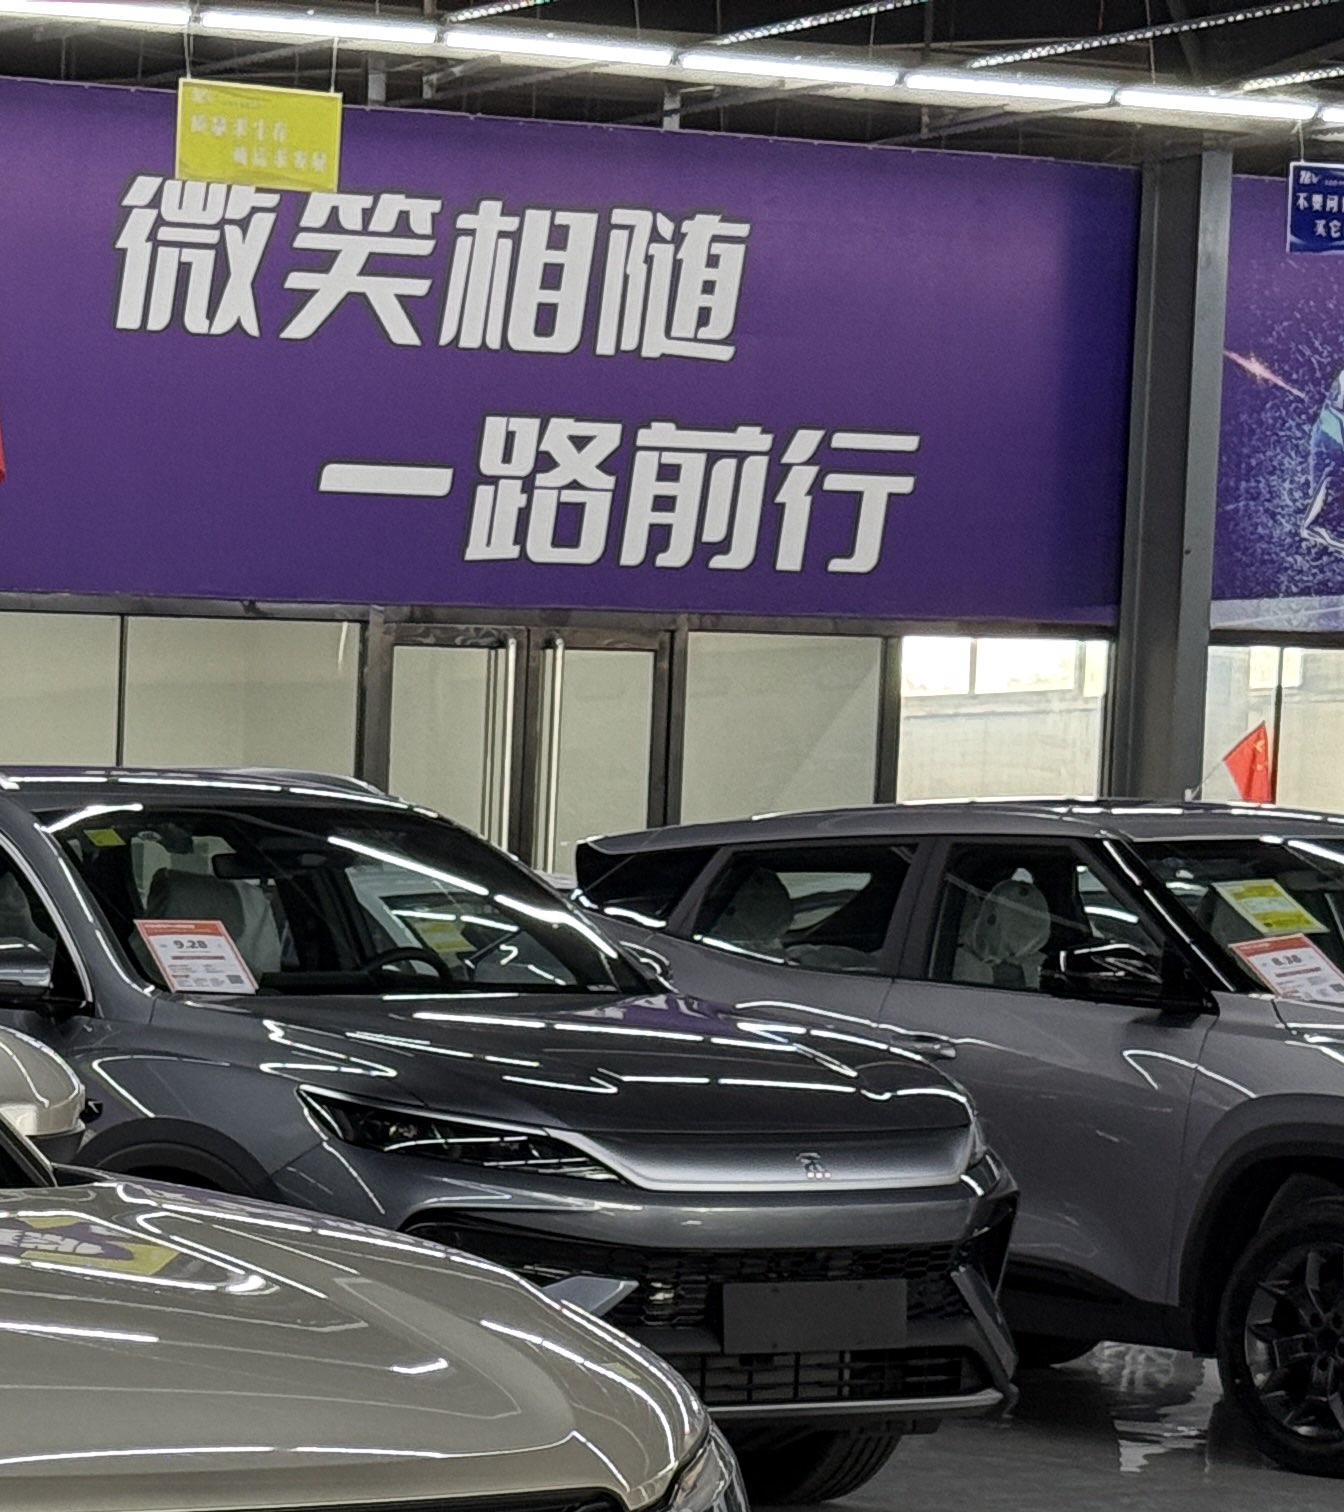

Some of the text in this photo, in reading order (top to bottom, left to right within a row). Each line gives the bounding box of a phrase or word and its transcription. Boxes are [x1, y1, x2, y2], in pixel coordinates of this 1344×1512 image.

[115, 176, 751, 361] 微笑相随
[318, 415, 921, 573] 一路前行
